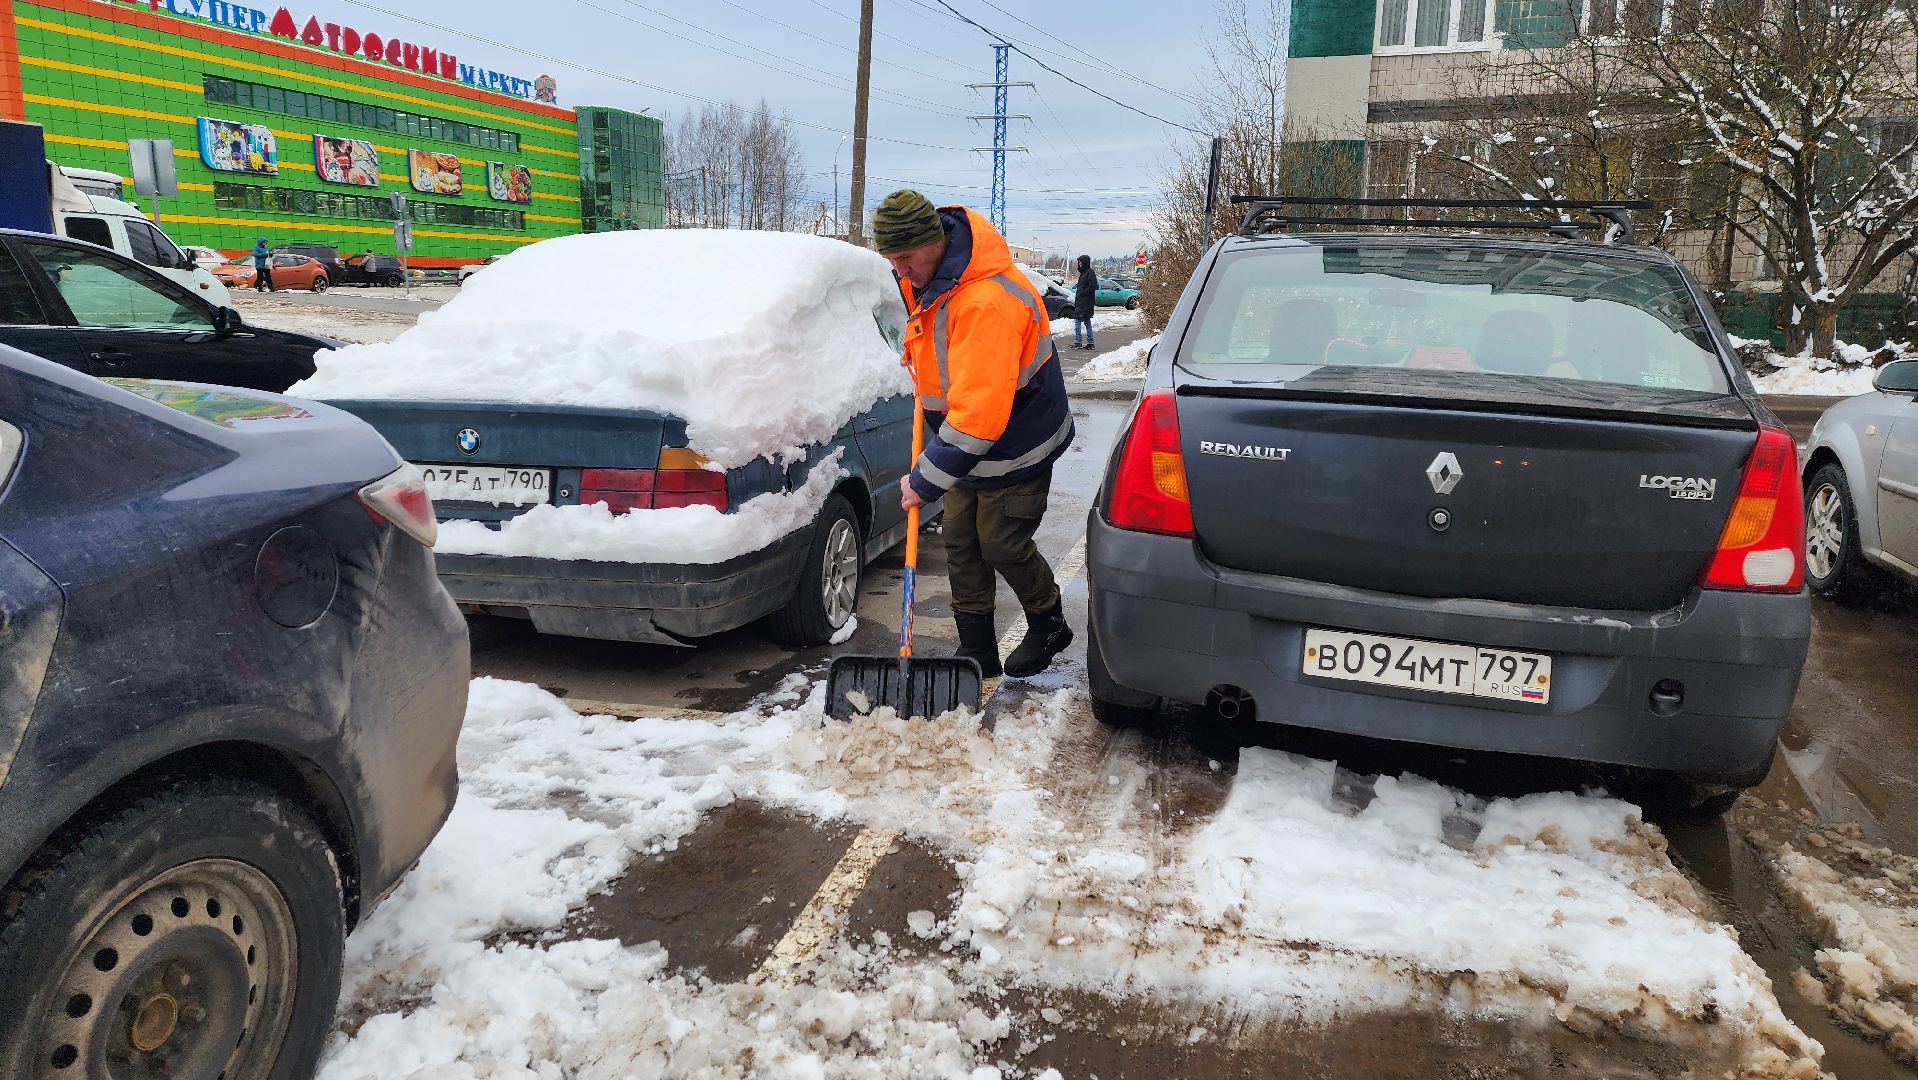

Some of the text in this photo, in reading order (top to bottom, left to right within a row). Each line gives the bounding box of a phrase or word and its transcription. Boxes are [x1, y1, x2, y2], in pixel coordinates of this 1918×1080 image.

[459, 62, 532, 99] МАРКЕТ
[1200, 441, 1292, 461] RENAULT
[1639, 474, 1717, 491] LOGAN
[1480, 652, 1539, 684] 797
[1490, 682, 1521, 696] RUS
